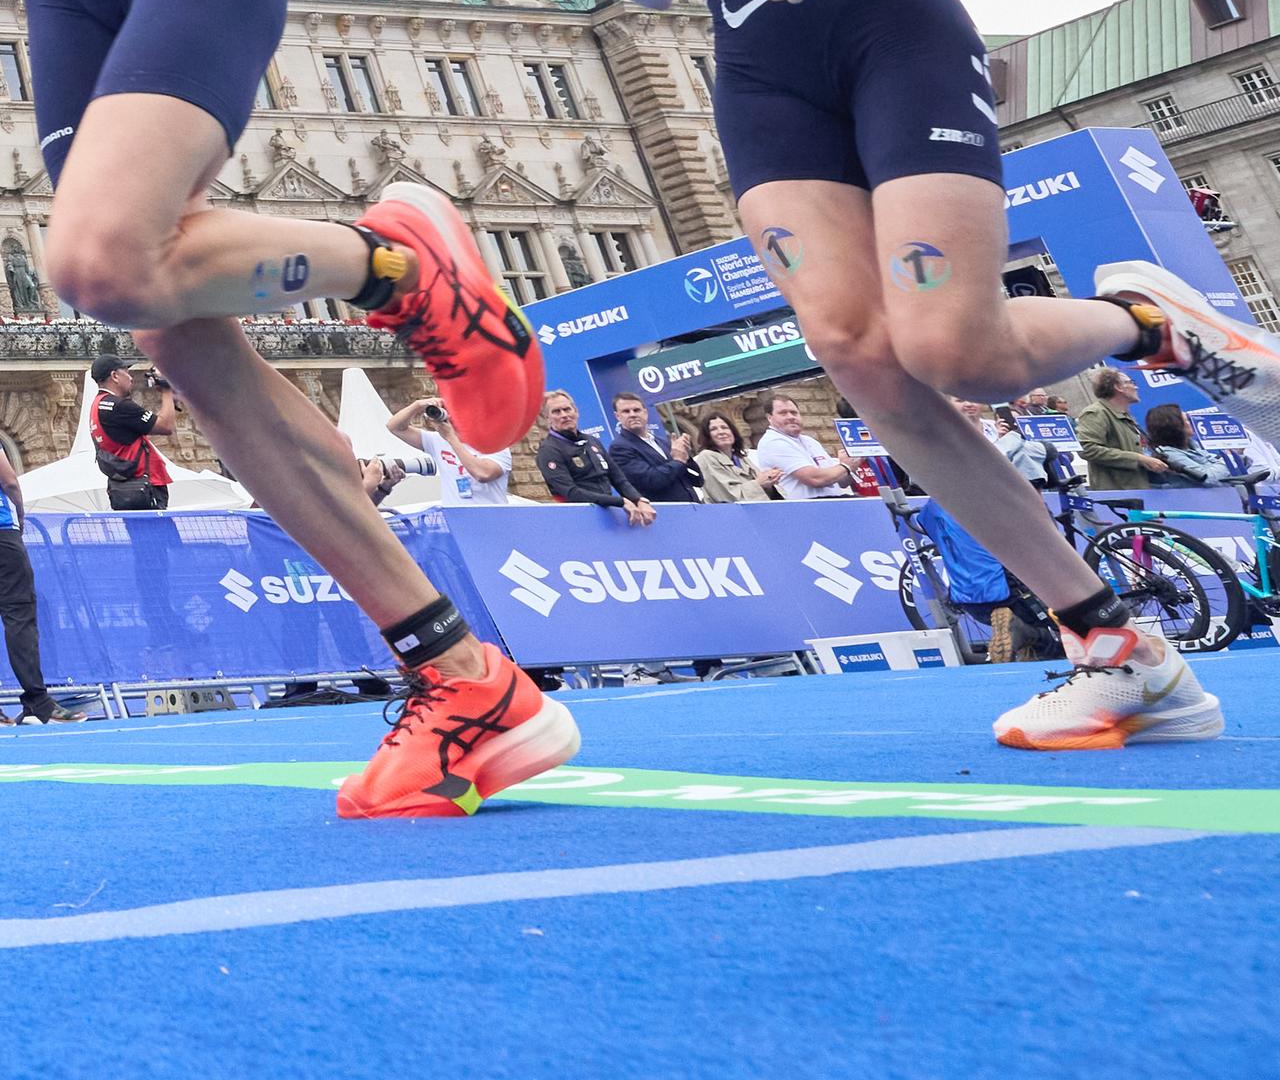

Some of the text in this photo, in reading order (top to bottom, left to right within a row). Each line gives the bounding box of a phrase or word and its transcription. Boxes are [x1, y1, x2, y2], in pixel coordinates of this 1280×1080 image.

[1003, 171, 1080, 210] ZUKI
[719, 258, 744, 272] World
[723, 264, 766, 281] Champions
[730, 284, 765, 300] HAMBURG
[556, 305, 630, 338] SUZUKI
[734, 321, 800, 353] WTCS
[667, 359, 702, 383] NTT
[841, 426, 854, 441] 2
[1024, 423, 1034, 438] 4
[1197, 421, 1208, 435] 6
[559, 556, 766, 603] SUZUKI
[260, 575, 355, 603] SUZ
[848, 652, 884, 663] SUZUKI
